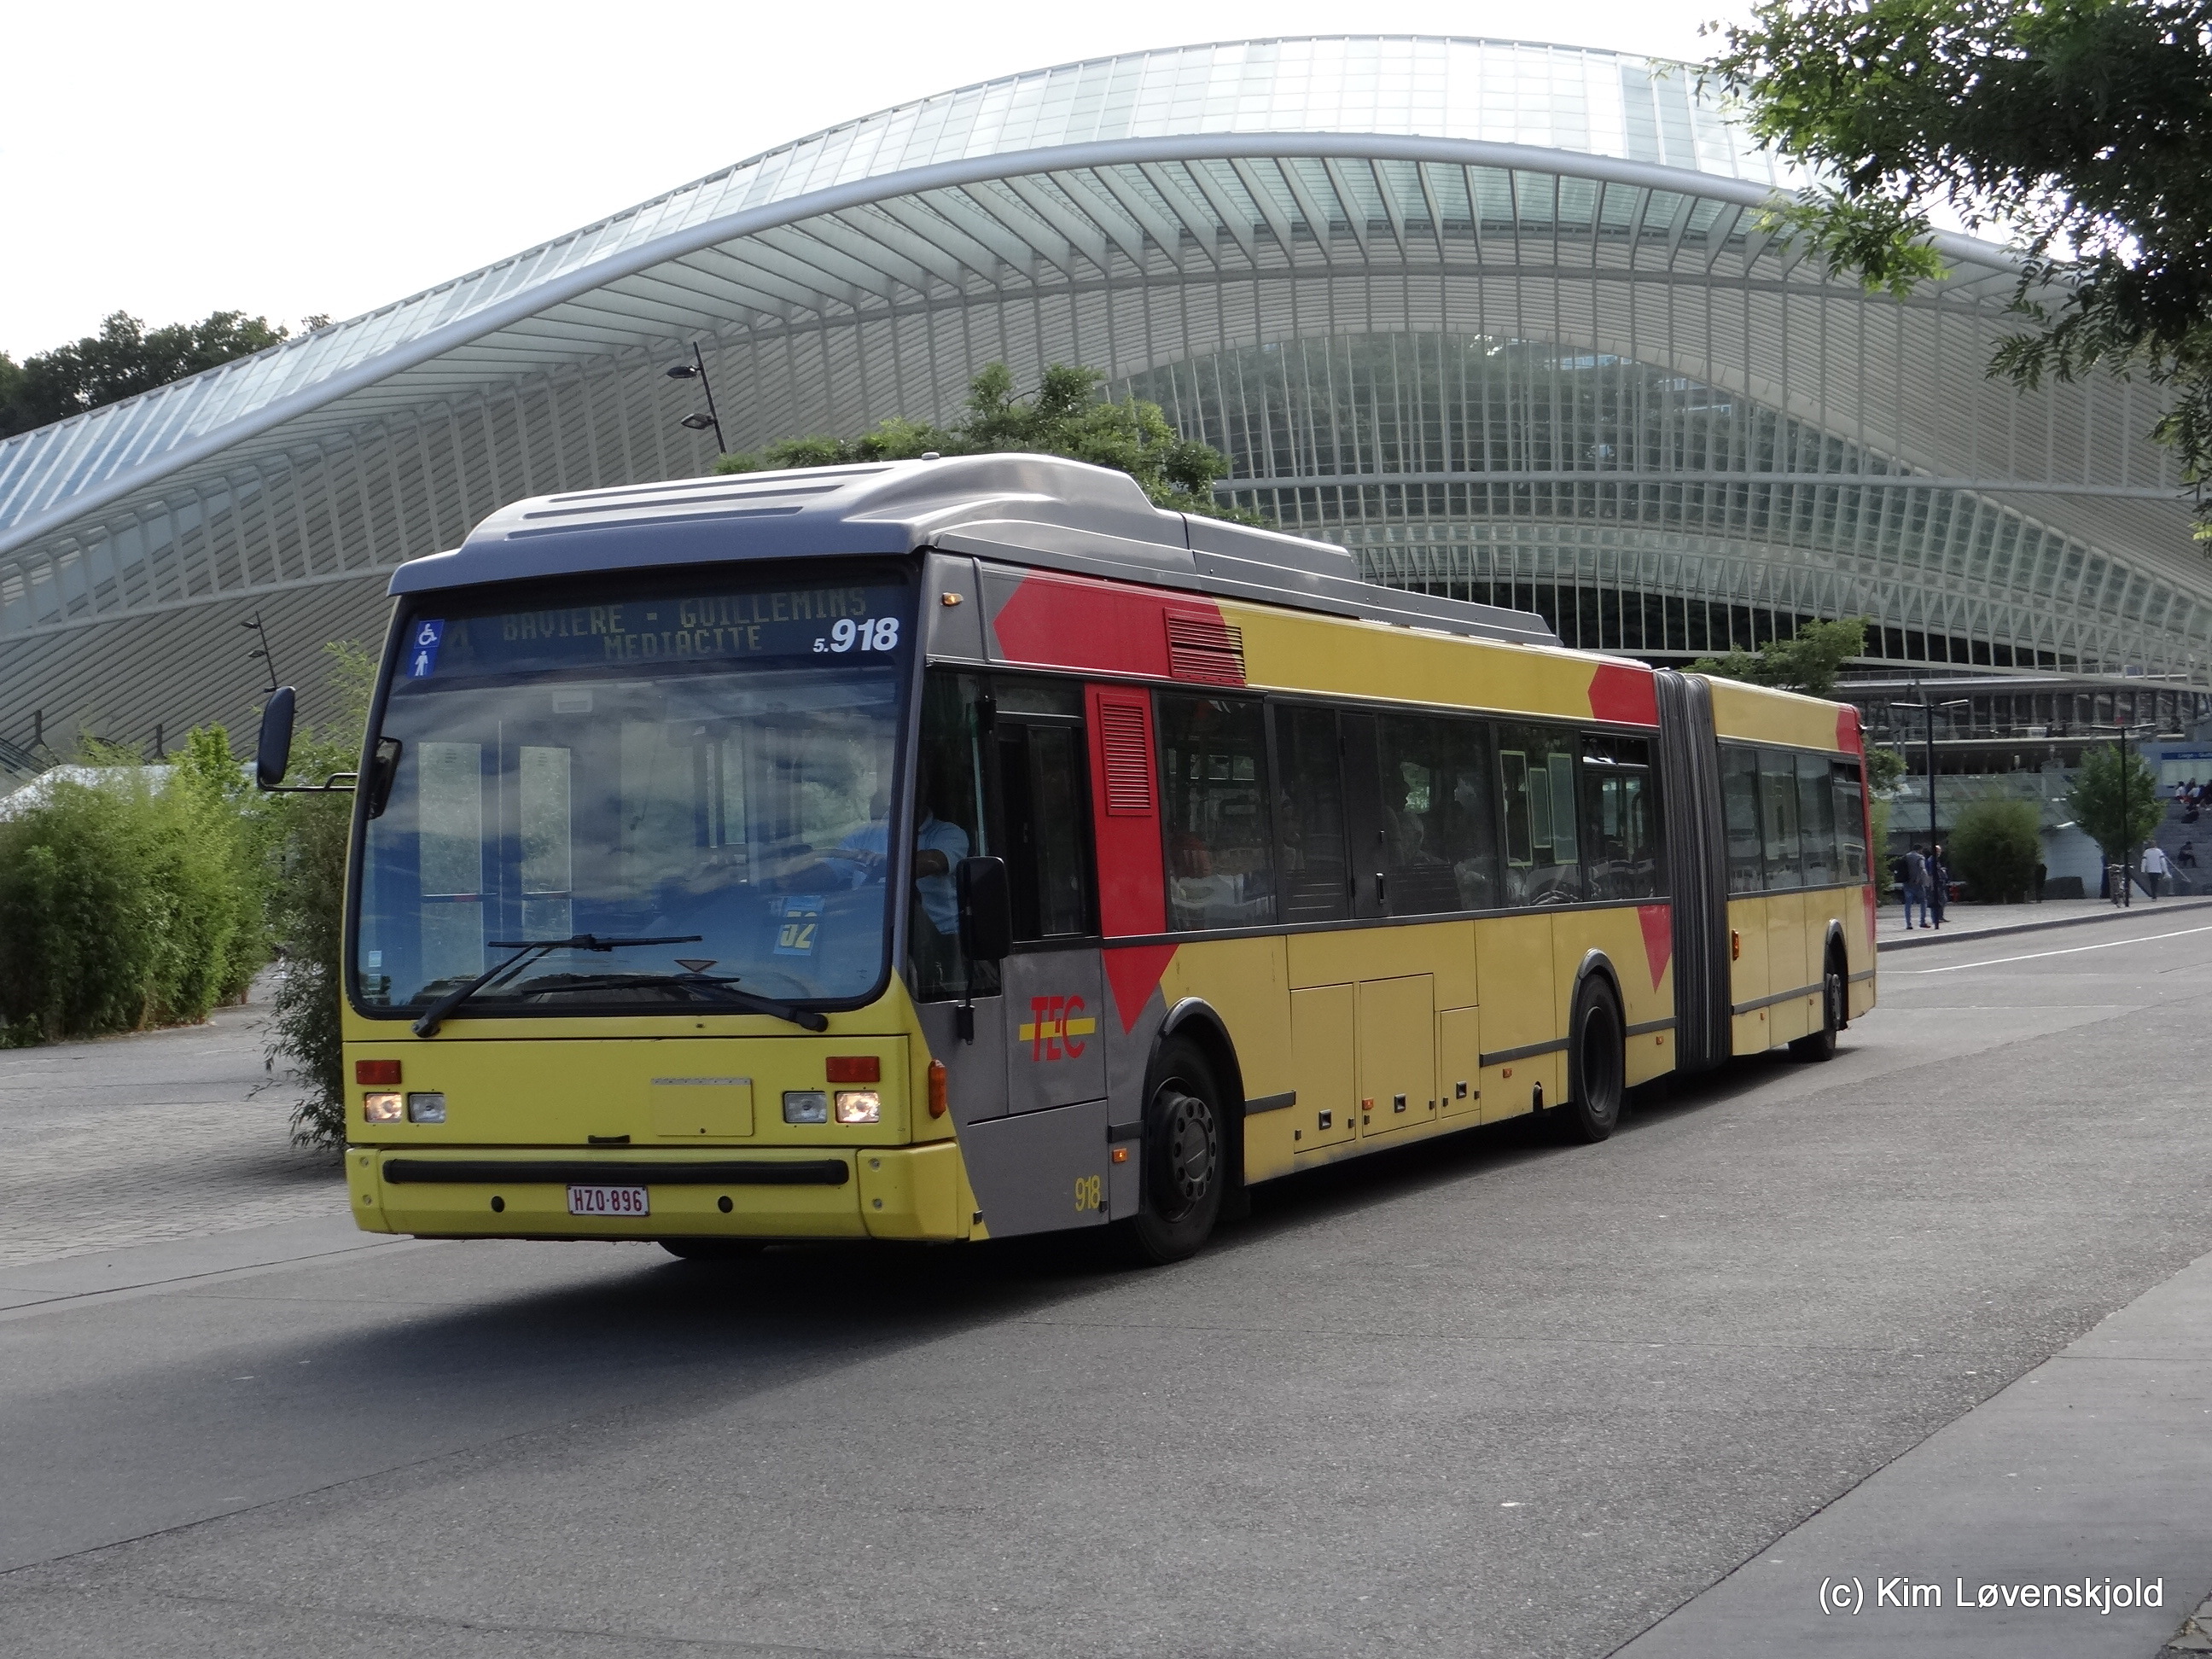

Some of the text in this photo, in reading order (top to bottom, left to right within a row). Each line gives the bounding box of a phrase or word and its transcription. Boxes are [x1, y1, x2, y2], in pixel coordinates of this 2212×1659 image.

[501, 605, 626, 642] BAVIERE
[679, 587, 867, 628] GUILLEMINS
[603, 625, 763, 661] MEDIACITE
[1030, 995, 1086, 1062] TEC
[1075, 1174, 1101, 1212] 918
